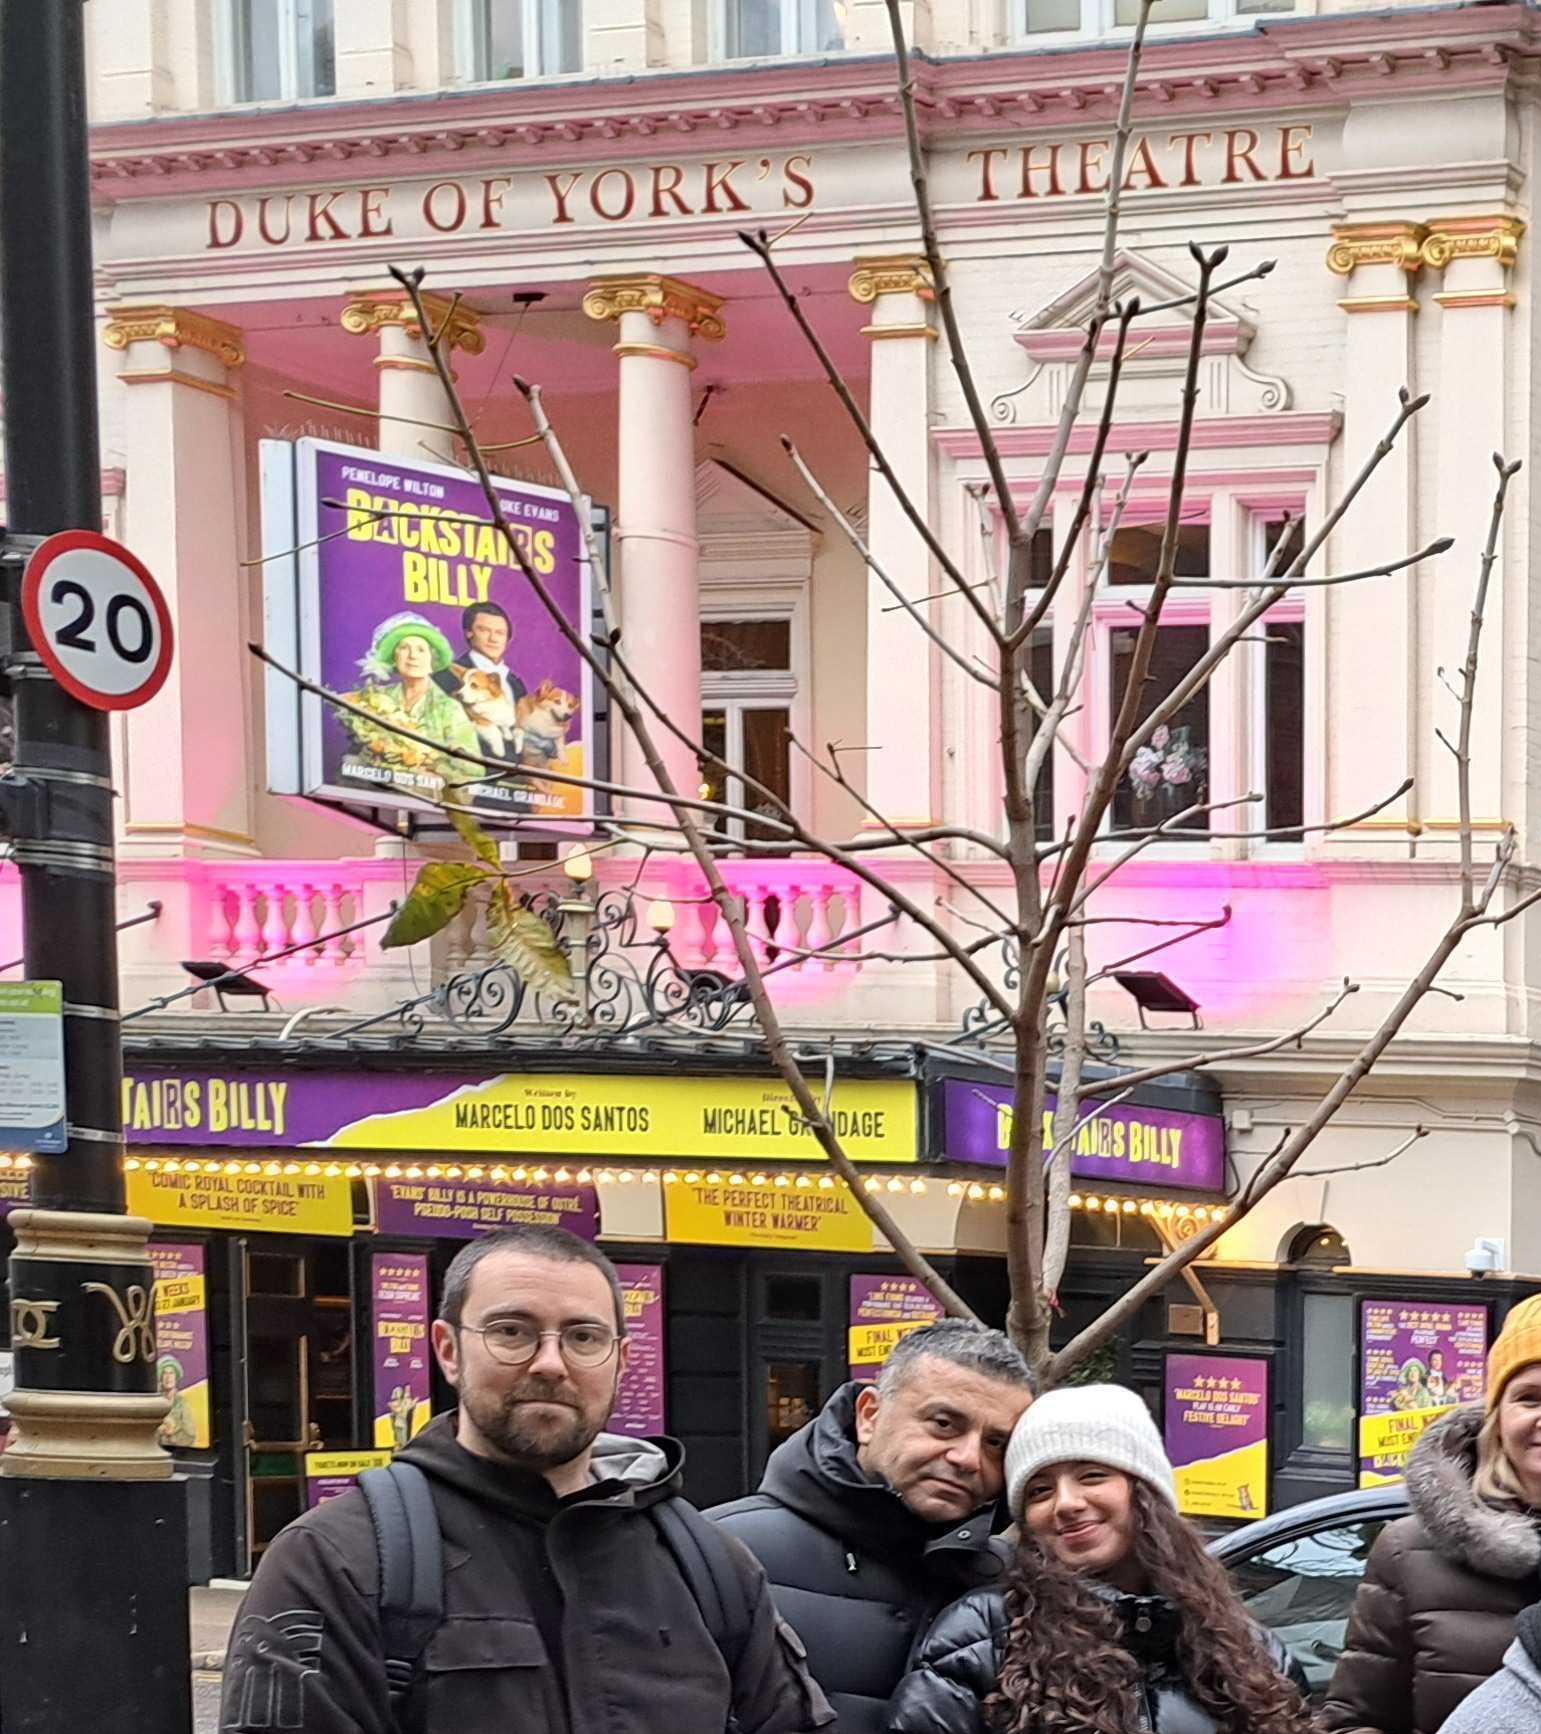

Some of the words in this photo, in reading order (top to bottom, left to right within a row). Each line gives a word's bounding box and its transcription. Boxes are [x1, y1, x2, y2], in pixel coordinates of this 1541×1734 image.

[205, 187, 394, 249] DUKE
[423, 177, 512, 233] OF
[544, 155, 815, 224] YORK'S
[966, 124, 1315, 200] THEATRE
[341, 465, 400, 491] PENELOPE
[403, 478, 445, 499] WILTON
[500, 499, 521, 516] UKE
[524, 505, 559, 523] EVANS
[403, 551, 492, 607] BILLY
[51, 580, 153, 663] 20
[122, 1077, 201, 1130] TAIRS
[208, 1078, 288, 1135] BILLY
[456, 1103, 535, 1131] MARCELO
[541, 1105, 574, 1131] DOS
[581, 1106, 649, 1133] SANTOS
[704, 1108, 781, 1136] MICHAEL
[1128, 1120, 1183, 1168] BILLY
[195, 1176, 233, 1194] ROYAL
[236, 1178, 294, 1198] COCKTAIL
[298, 1182, 325, 1201] WITH
[723, 1189, 776, 1210] PERFECT
[781, 1192, 849, 1215] THEATRICAL
[179, 1194, 188, 1208] A
[190, 1196, 238, 1214] SPLASH
[243, 1198, 258, 1214] OF
[724, 1210, 768, 1229] WINTER
